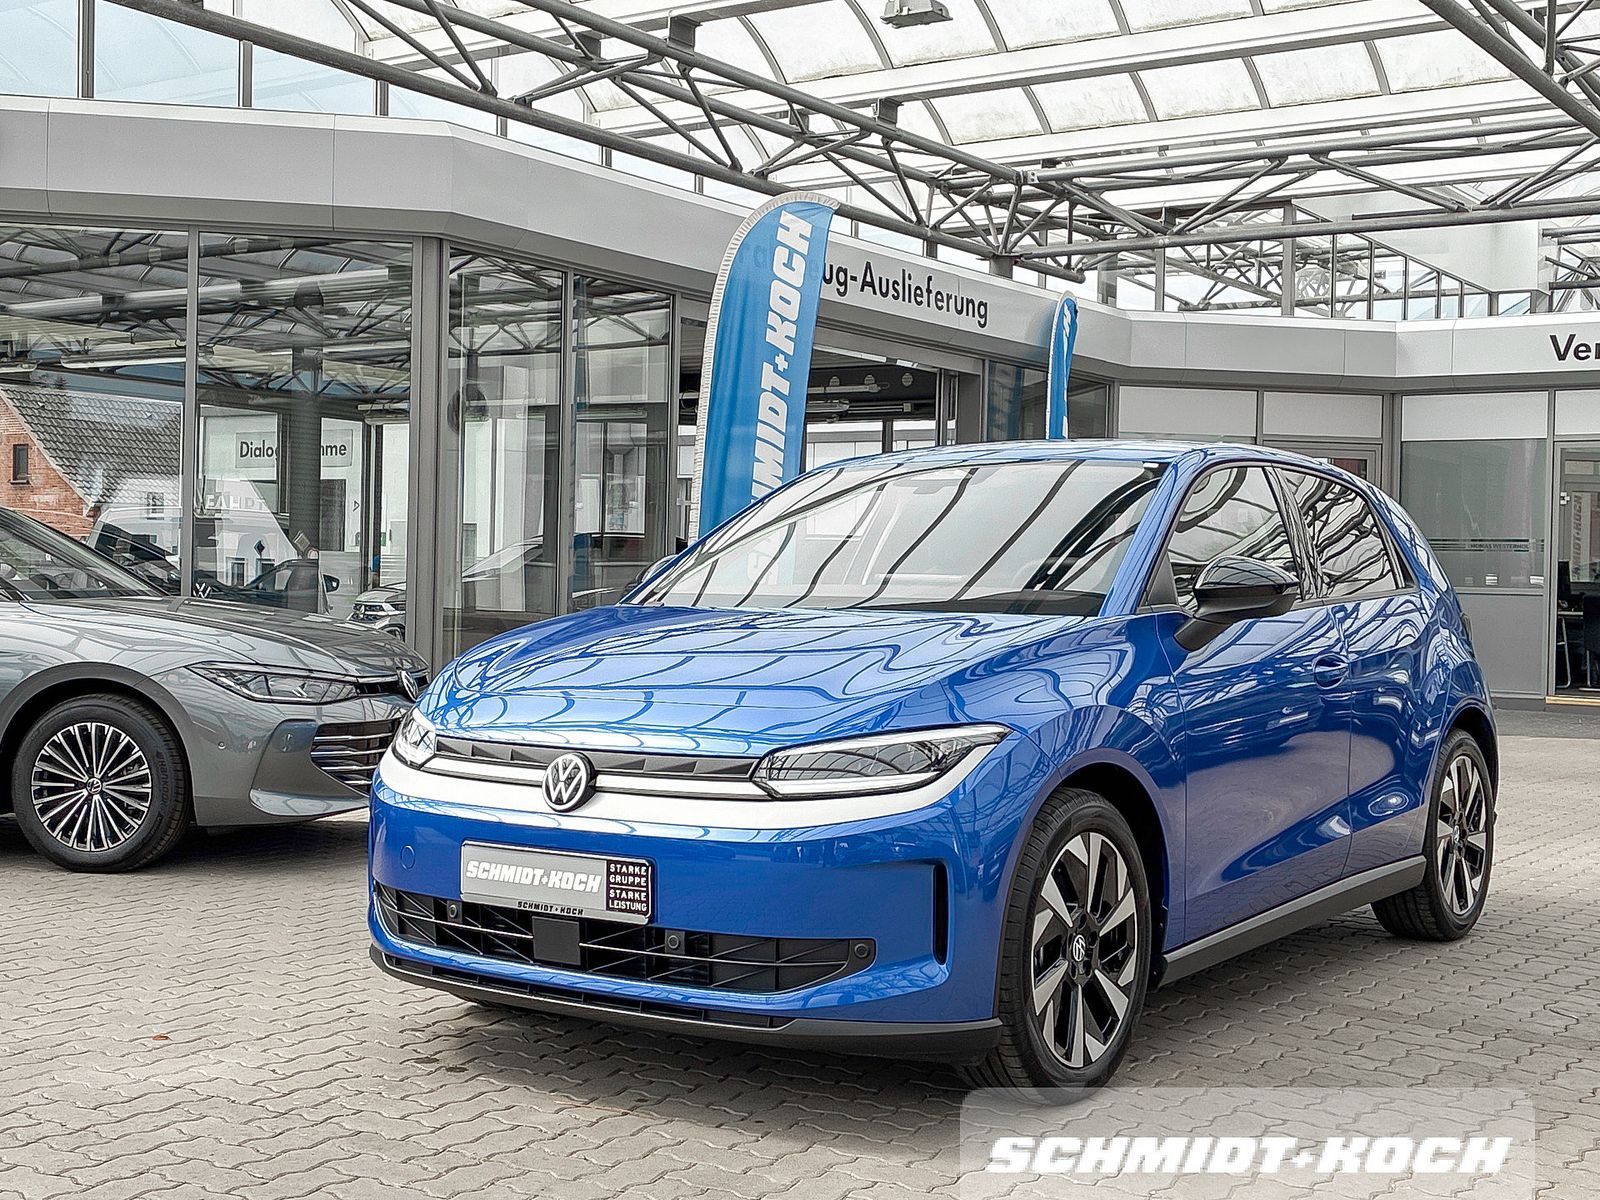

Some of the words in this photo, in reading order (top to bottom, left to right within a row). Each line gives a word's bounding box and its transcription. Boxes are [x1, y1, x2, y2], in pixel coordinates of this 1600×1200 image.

[609, 863, 647, 875] STARKE
[466, 860, 602, 893] SCHMIDT+KOCH
[609, 874, 647, 886] GRUPPE
[609, 889, 647, 901] STARKE
[609, 899, 647, 911] LEISTUNG
